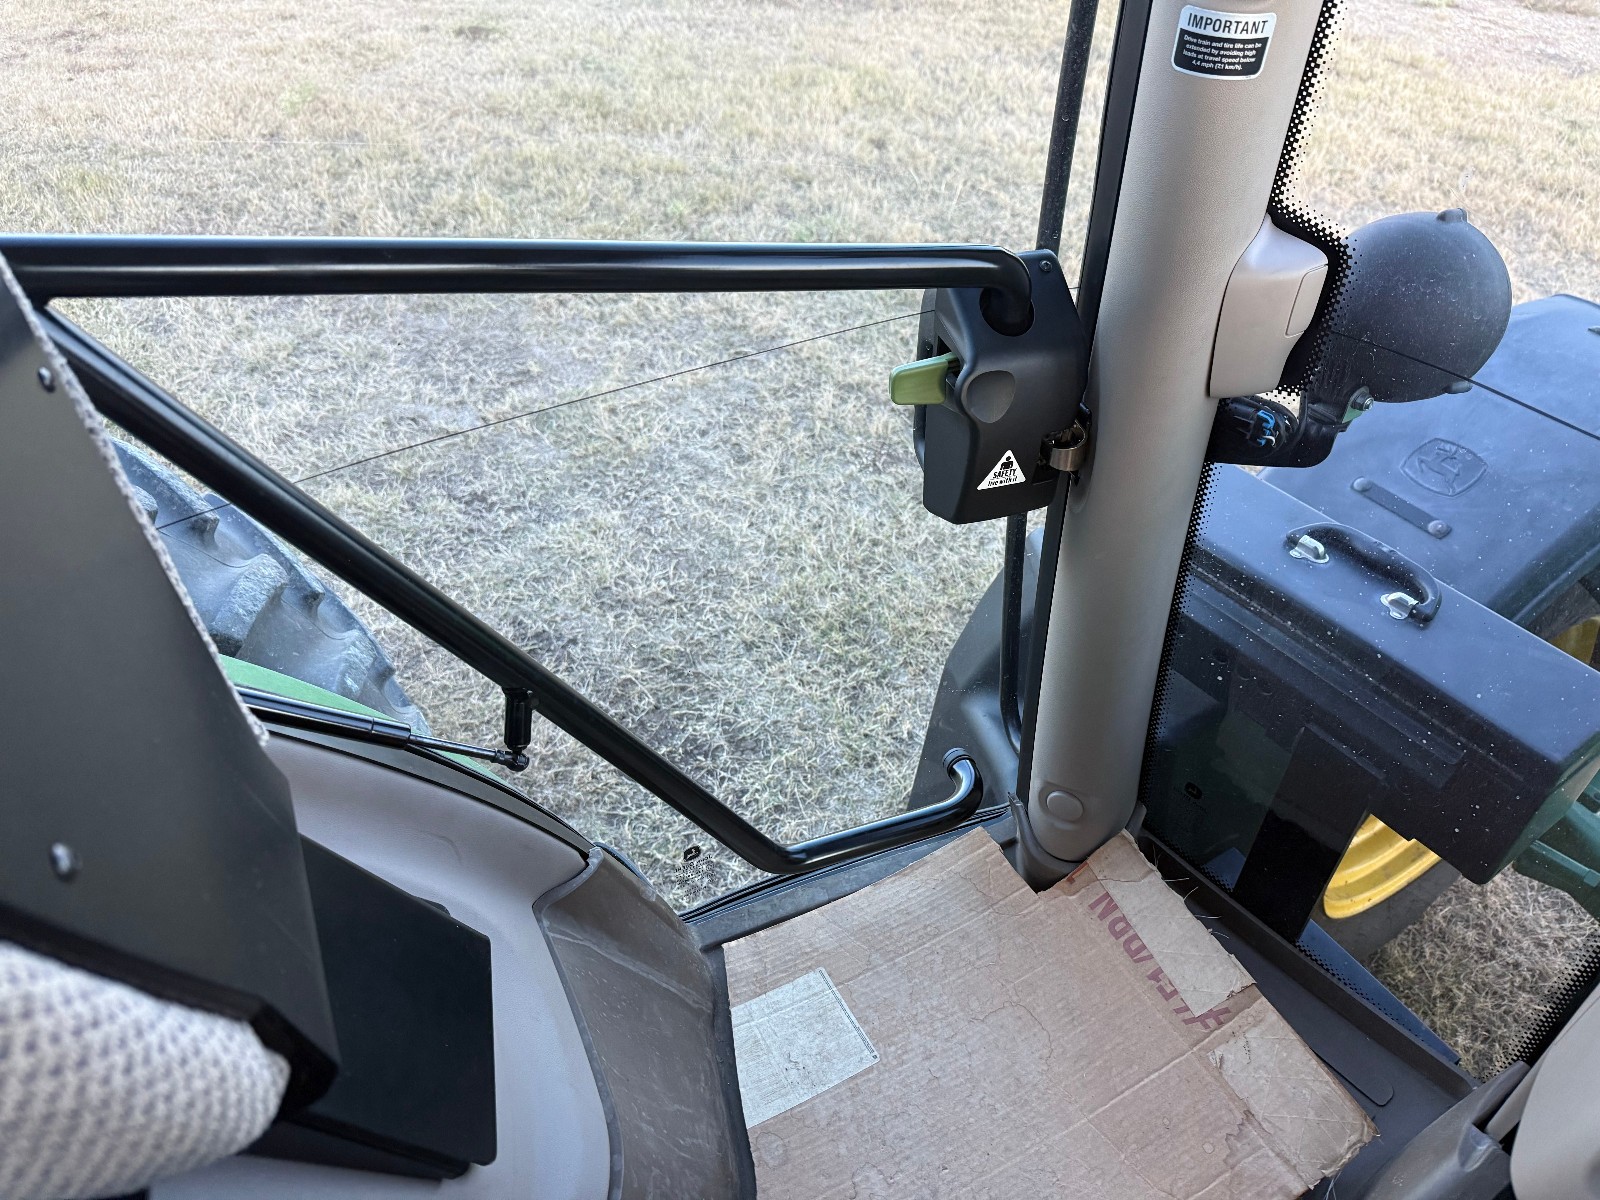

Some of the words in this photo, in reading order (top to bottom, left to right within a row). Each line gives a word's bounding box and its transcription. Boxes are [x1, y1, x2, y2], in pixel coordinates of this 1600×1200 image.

[1187, 13, 1268, 34] IMPORTANT
[1183, 34, 1198, 43] Drive
[1197, 38, 1211, 46] train
[1182, 49, 1197, 58] loads
[1204, 54, 1223, 62] travel
[1185, 43, 1211, 53] extended
[1211, 48, 1219, 56] by
[1244, 49, 1257, 57] high
[1200, 61, 1214, 69] mph
[993, 468, 1018, 479] SAFETY
